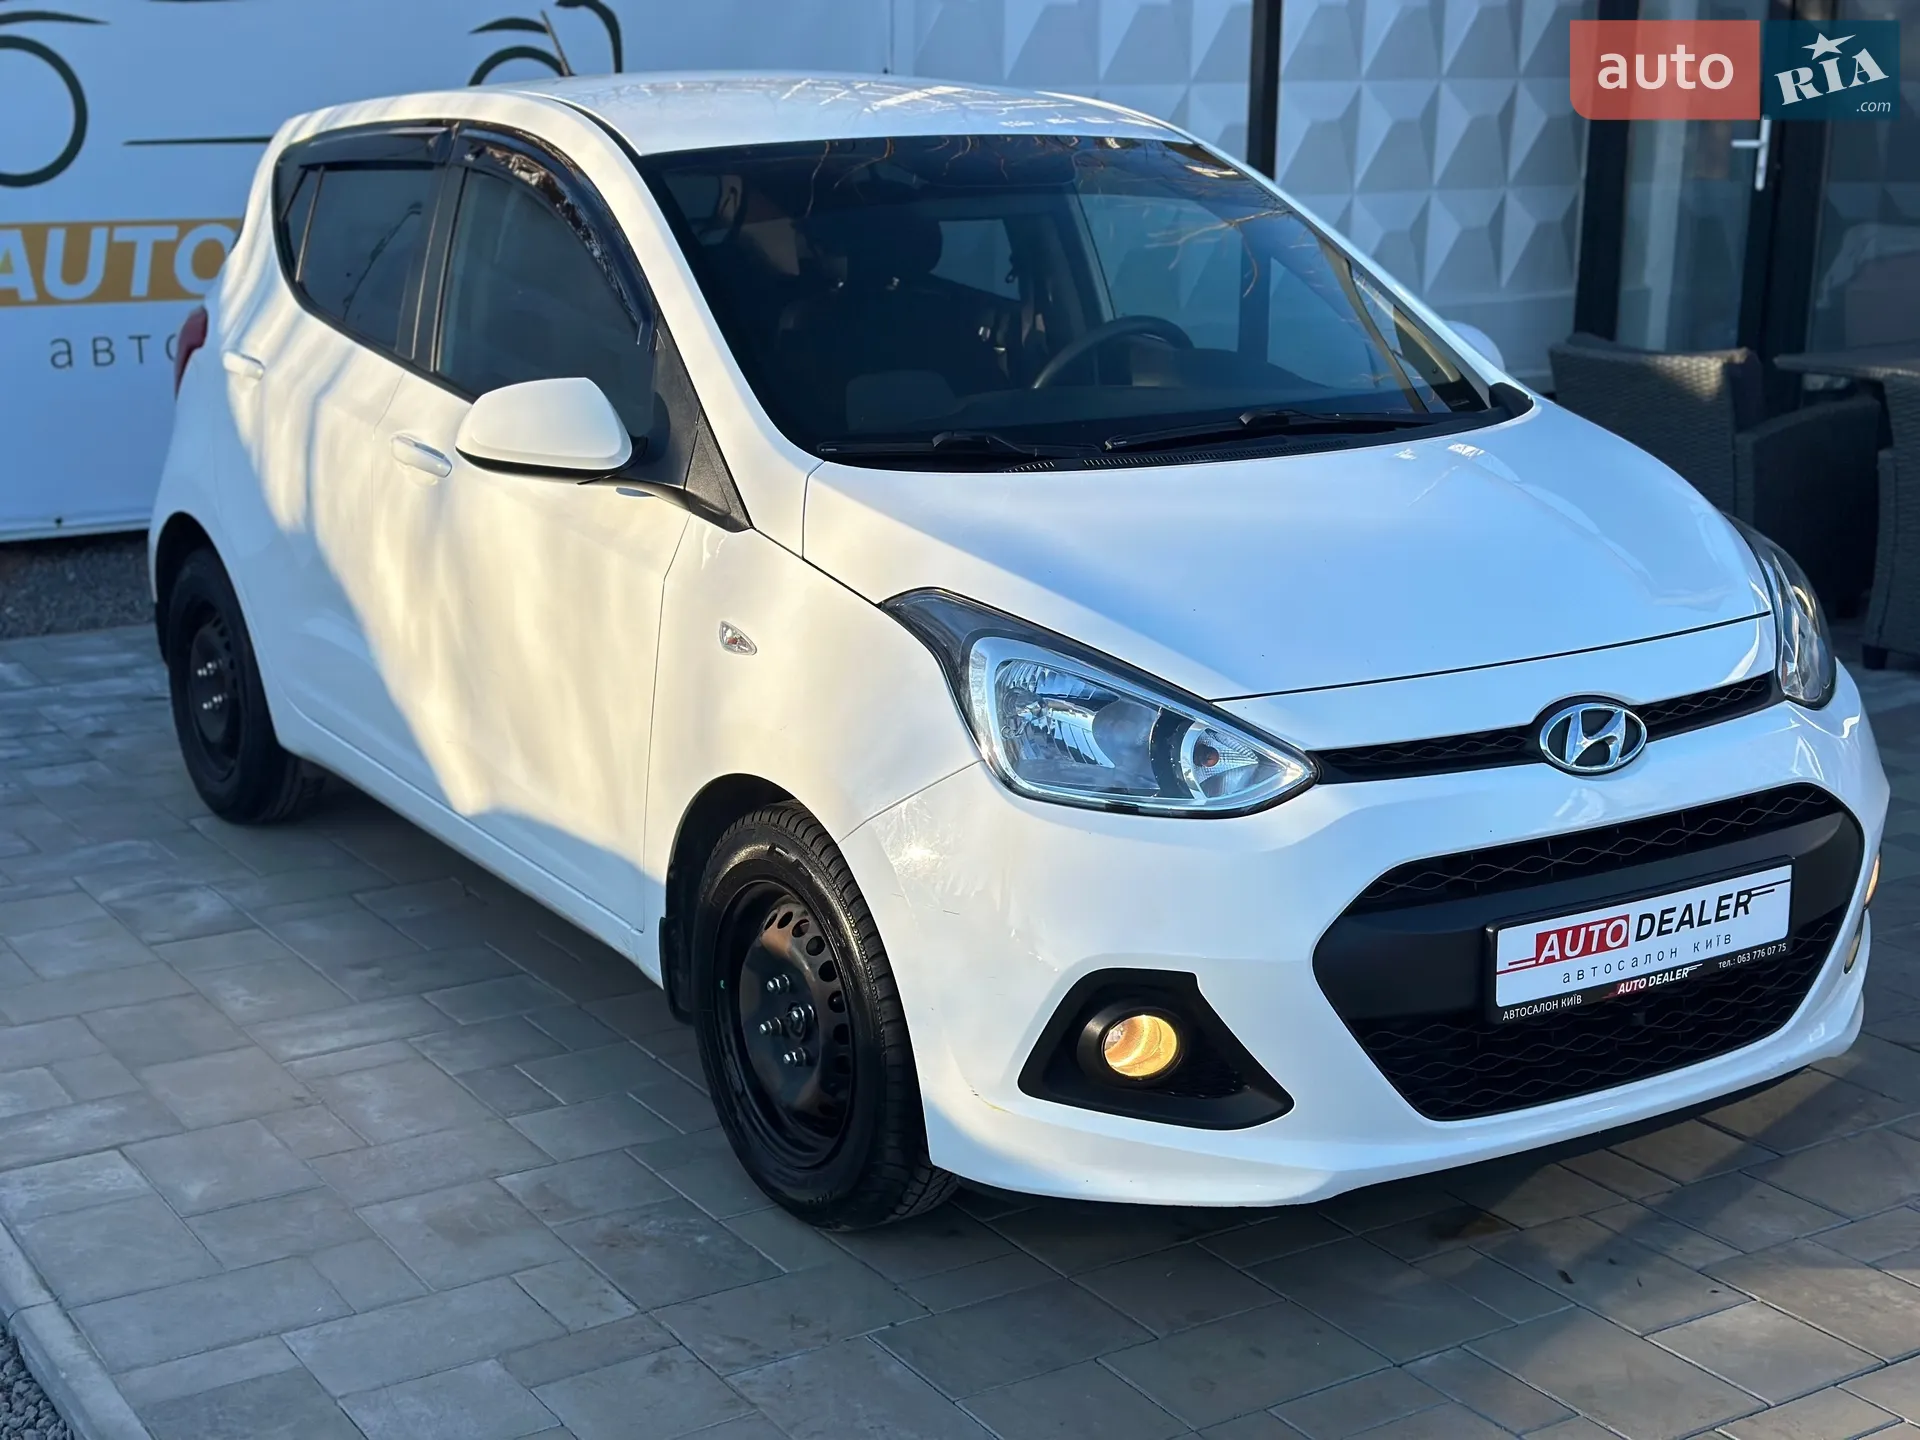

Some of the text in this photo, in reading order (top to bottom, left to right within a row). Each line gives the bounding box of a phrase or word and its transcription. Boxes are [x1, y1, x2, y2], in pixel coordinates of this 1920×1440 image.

[0, 223, 237, 302] AUTO
[1538, 887, 1752, 964] AUTO DEALER
[1562, 946, 1678, 984] автосалон
[1737, 952, 1751, 964] 063
[1752, 948, 1766, 960] 776
[1767, 945, 1777, 956] 07
[1777, 942, 1787, 953] 75
[1617, 967, 1689, 995] AUTO DEALER
[1502, 994, 1582, 1021] АВТОСАЛОН КИЇВ
